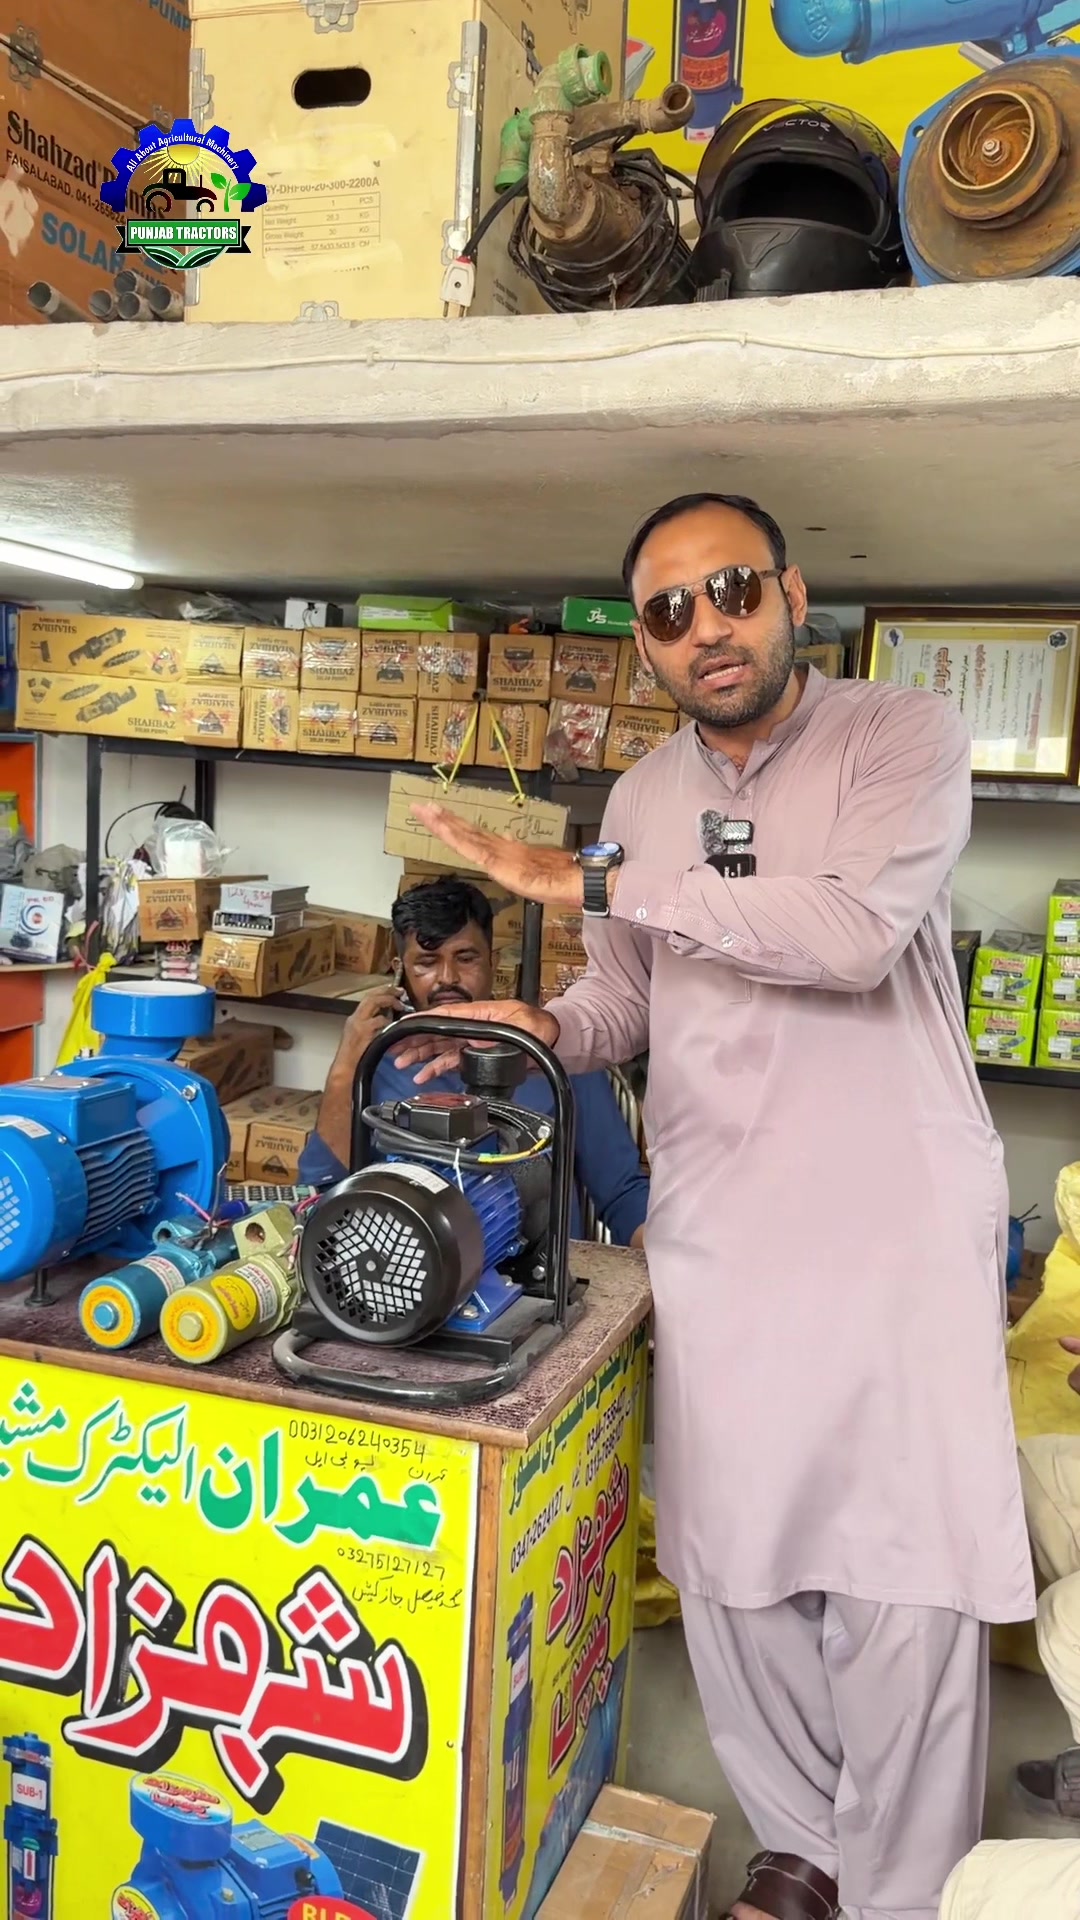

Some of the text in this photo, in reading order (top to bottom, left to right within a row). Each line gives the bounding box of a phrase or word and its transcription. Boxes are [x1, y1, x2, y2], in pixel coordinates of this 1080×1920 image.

[32, 623, 77, 634] SHAHBAZ
[492, 677, 543, 688] SHAHBAZ
[362, 707, 409, 717] SHAHBAZ
[128, 717, 176, 730] SHAHBAZ
[146, 893, 192, 903] SHAHBAZ
[255, 1139, 299, 1153] SHAHBAZ
[26, 1399, 196, 1502] الیکٹرک
[200, 1431, 443, 1548] عمران
[547, 1453, 629, 1647] شہزاد
[337, 1546, 446, 1581] 03275127127
[0, 1534, 428, 1815] شہزاد
[16, 1782, 43, 1802] SUB-1
